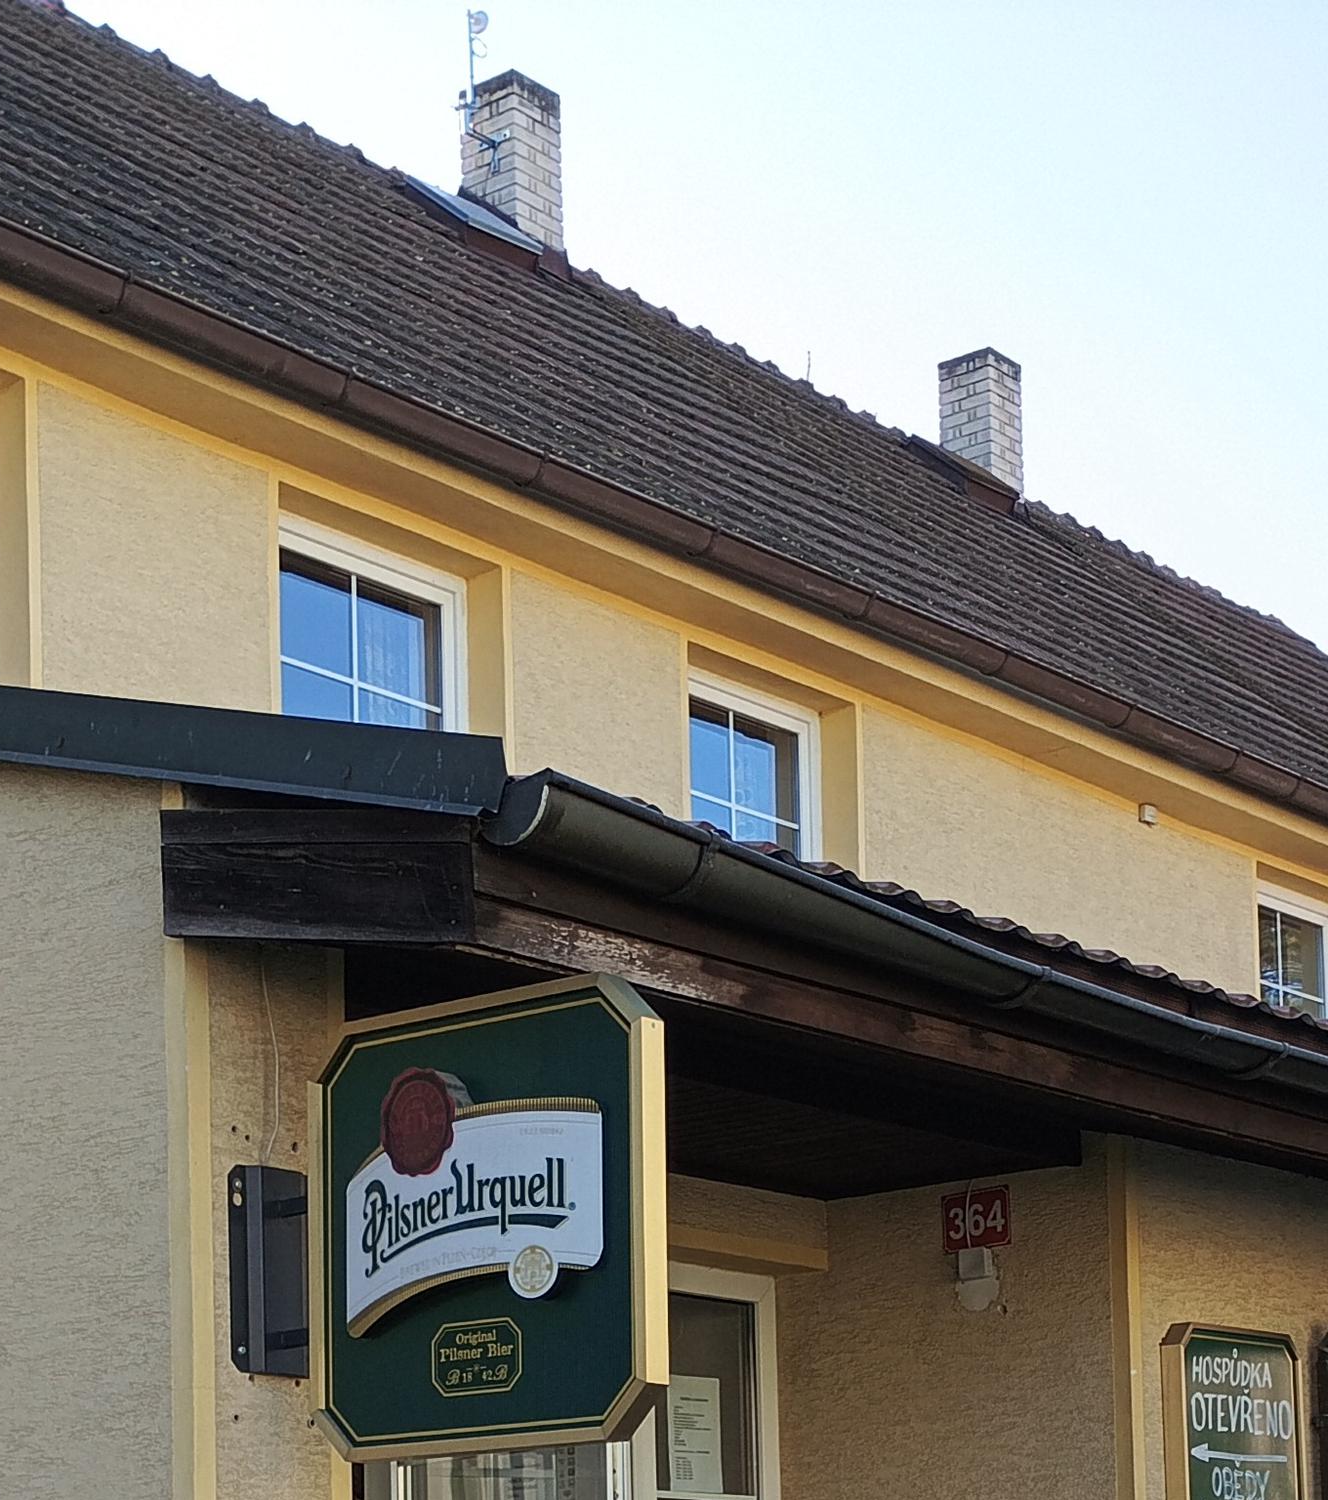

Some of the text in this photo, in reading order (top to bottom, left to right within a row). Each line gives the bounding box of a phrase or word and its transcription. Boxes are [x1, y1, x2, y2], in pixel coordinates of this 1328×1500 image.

[362, 1157, 567, 1278] Pilsner Urquell
[949, 1199, 1005, 1239] 364
[440, 1343, 513, 1362] Pilsner Bier
[456, 1329, 496, 1346] Original
[1192, 1348, 1272, 1389] HOSPŮDKA
[1190, 1389, 1293, 1440] OTEVŘENO
